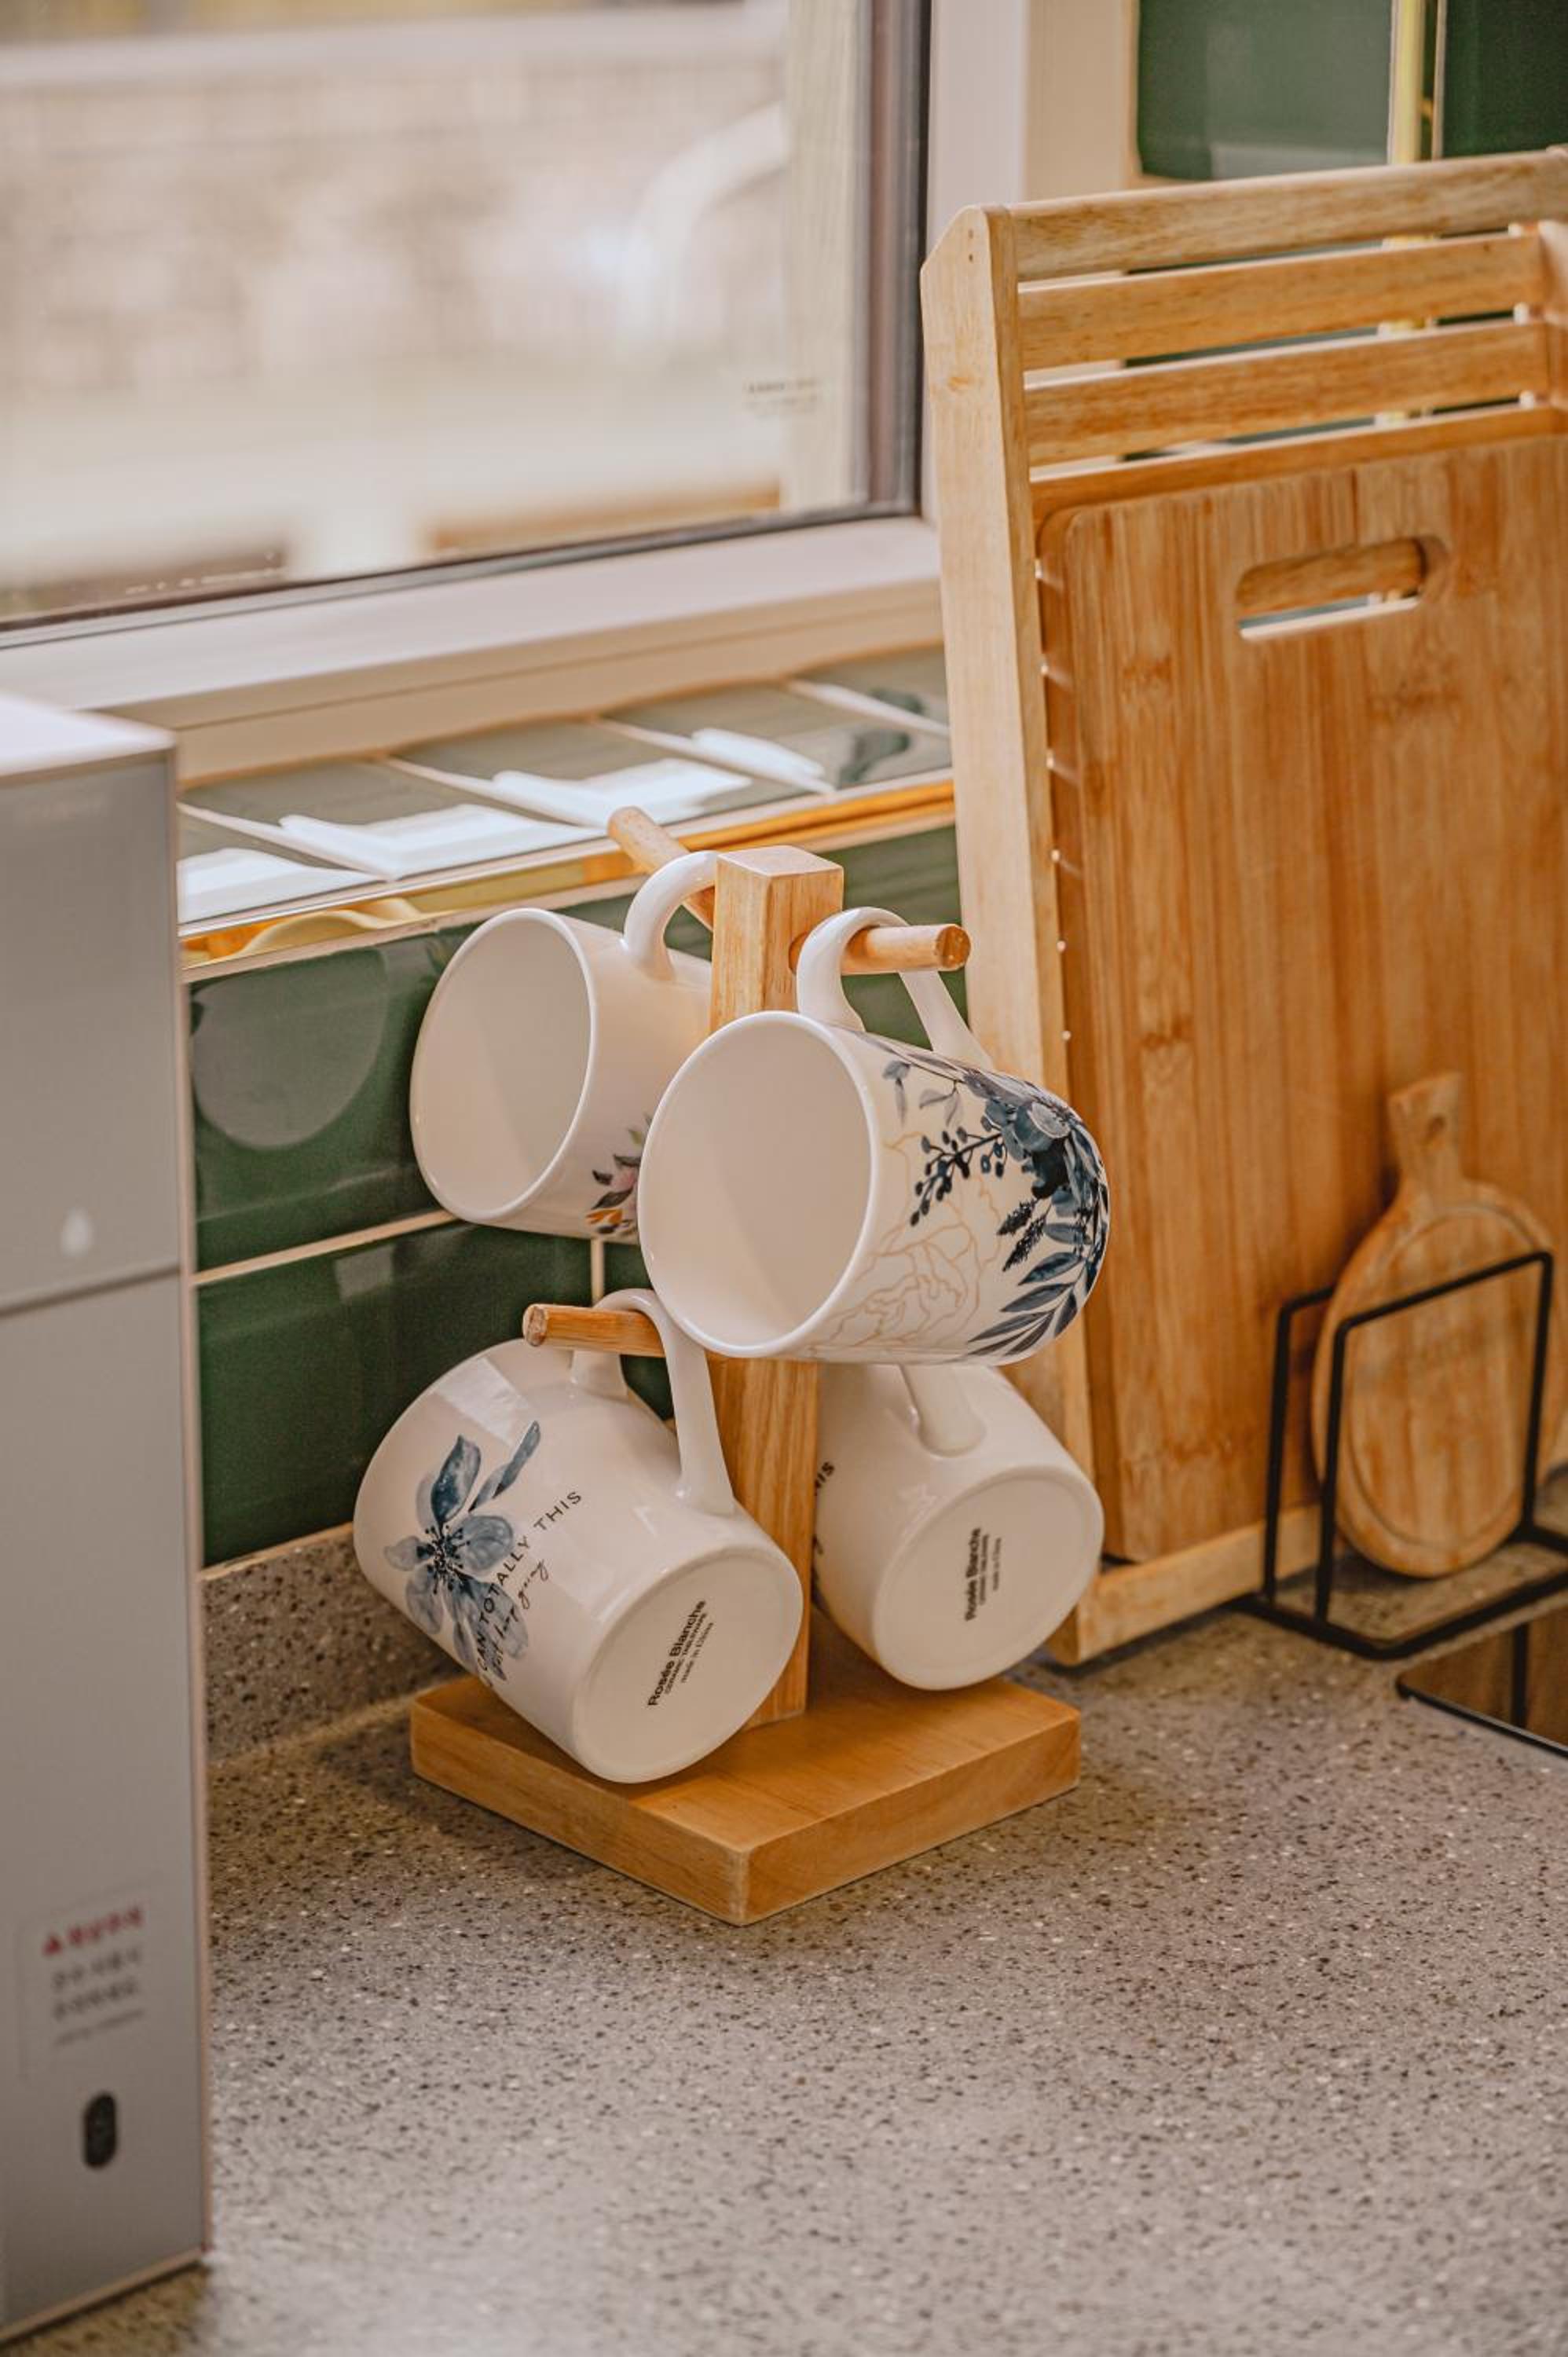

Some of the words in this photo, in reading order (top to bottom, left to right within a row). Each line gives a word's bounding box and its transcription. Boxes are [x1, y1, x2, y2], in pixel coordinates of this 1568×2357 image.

[533, 1491, 582, 1531] THIS
[479, 1536, 530, 1624] TOTALLY
[477, 1631, 488, 1672] CAN
[669, 1600, 706, 1657] Blanche
